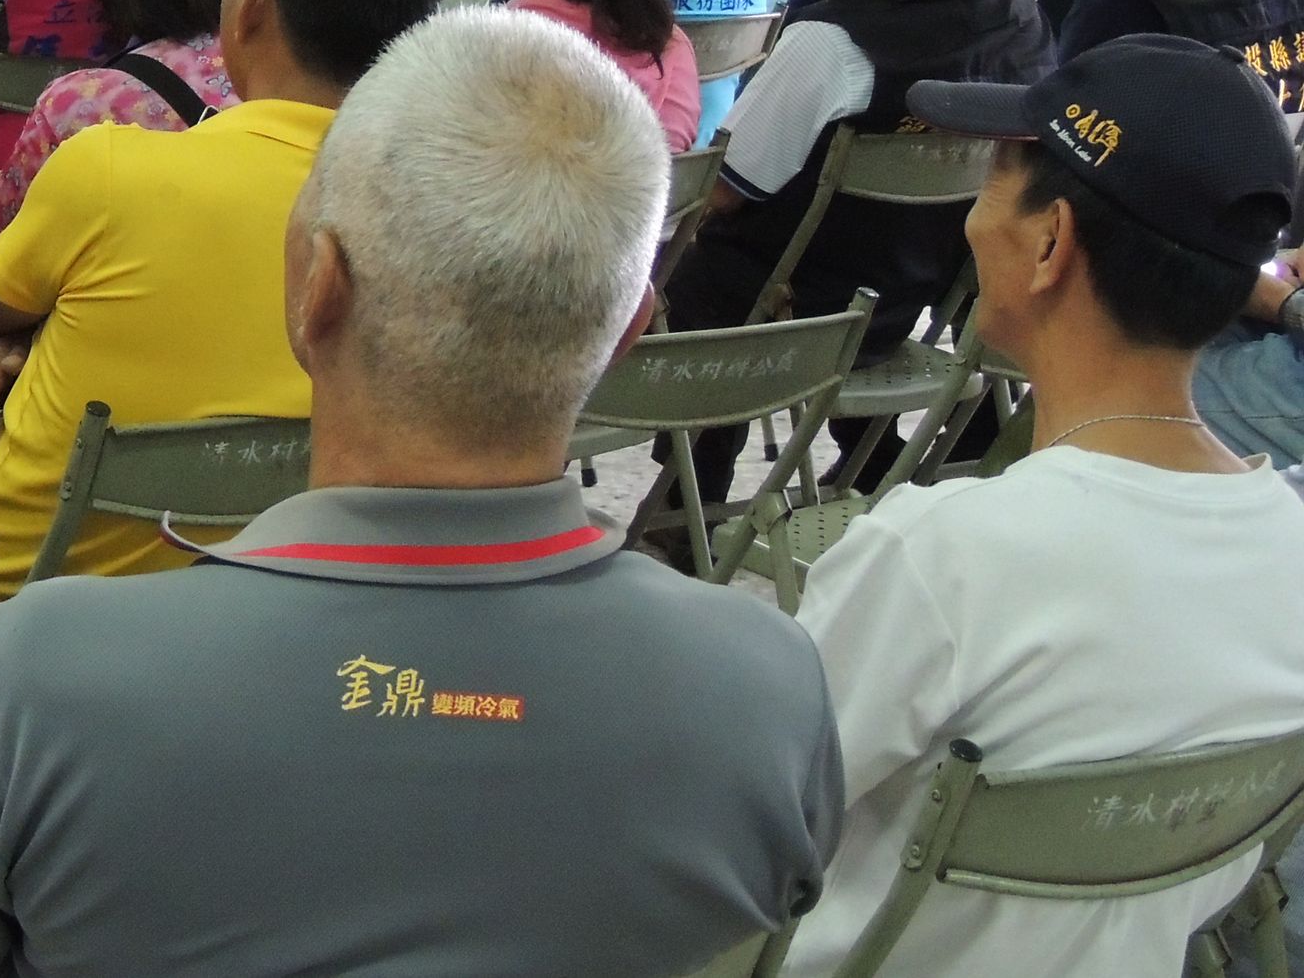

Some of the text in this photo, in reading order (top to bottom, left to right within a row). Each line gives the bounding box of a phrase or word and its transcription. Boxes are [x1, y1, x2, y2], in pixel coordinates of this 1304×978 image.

[199, 439, 311, 468] 清水村
[337, 654, 426, 717] 金鼎
[431, 692, 520, 719] 變頻冷氣
